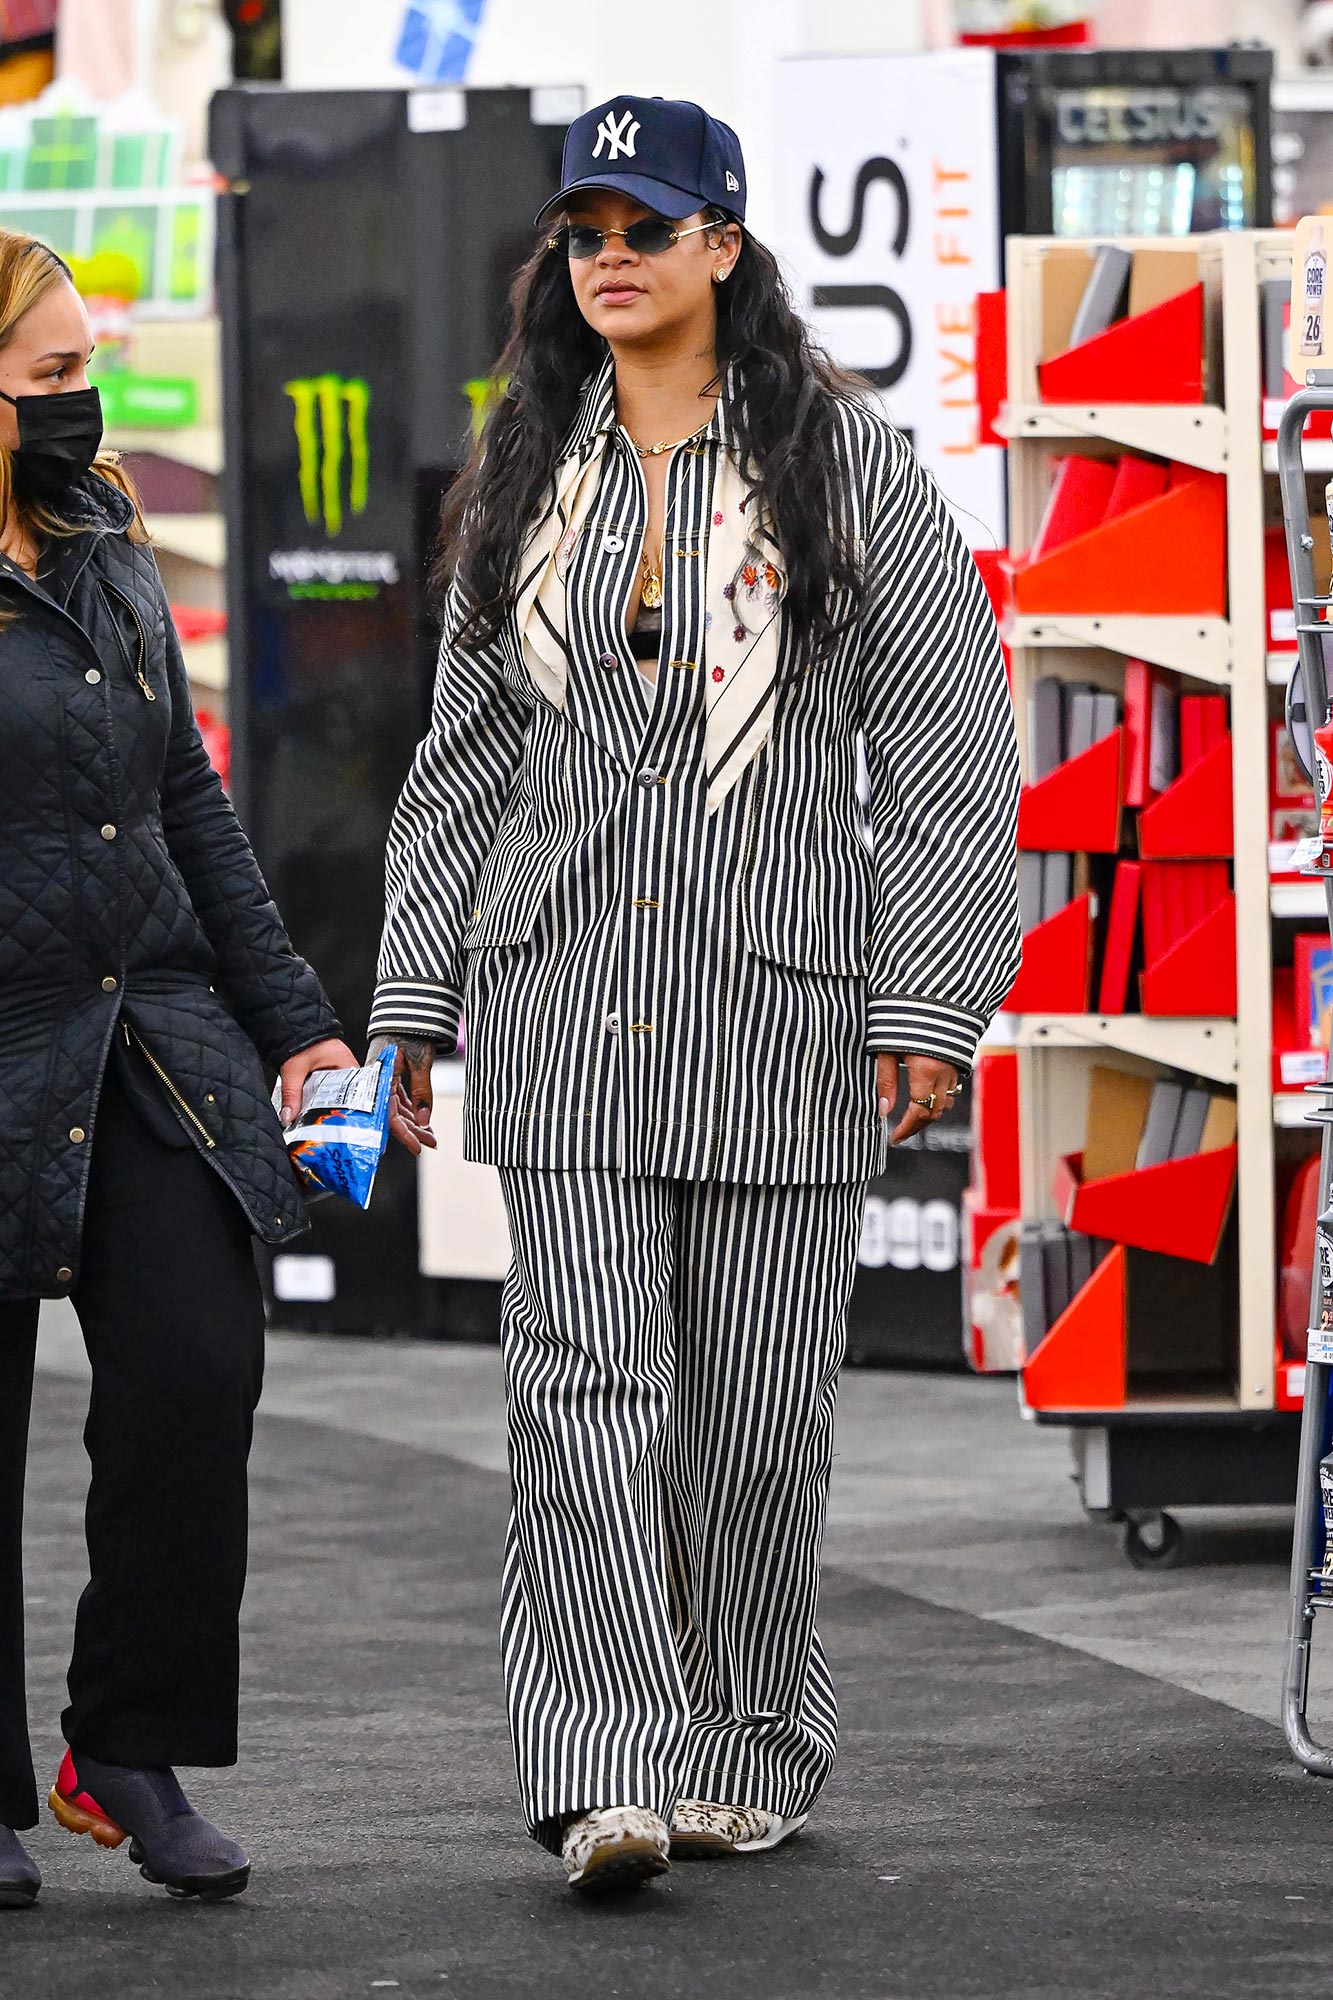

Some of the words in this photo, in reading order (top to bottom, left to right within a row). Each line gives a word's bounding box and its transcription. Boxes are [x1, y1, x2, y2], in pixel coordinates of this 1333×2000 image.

[591, 110, 642, 161] NY
[1057, 89, 1220, 142] CELSIUS
[932, 157, 971, 264] FIT
[1306, 267, 1323, 284] CORE
[1306, 284, 1323, 296] POWER
[936, 303, 977, 456] LIVE
